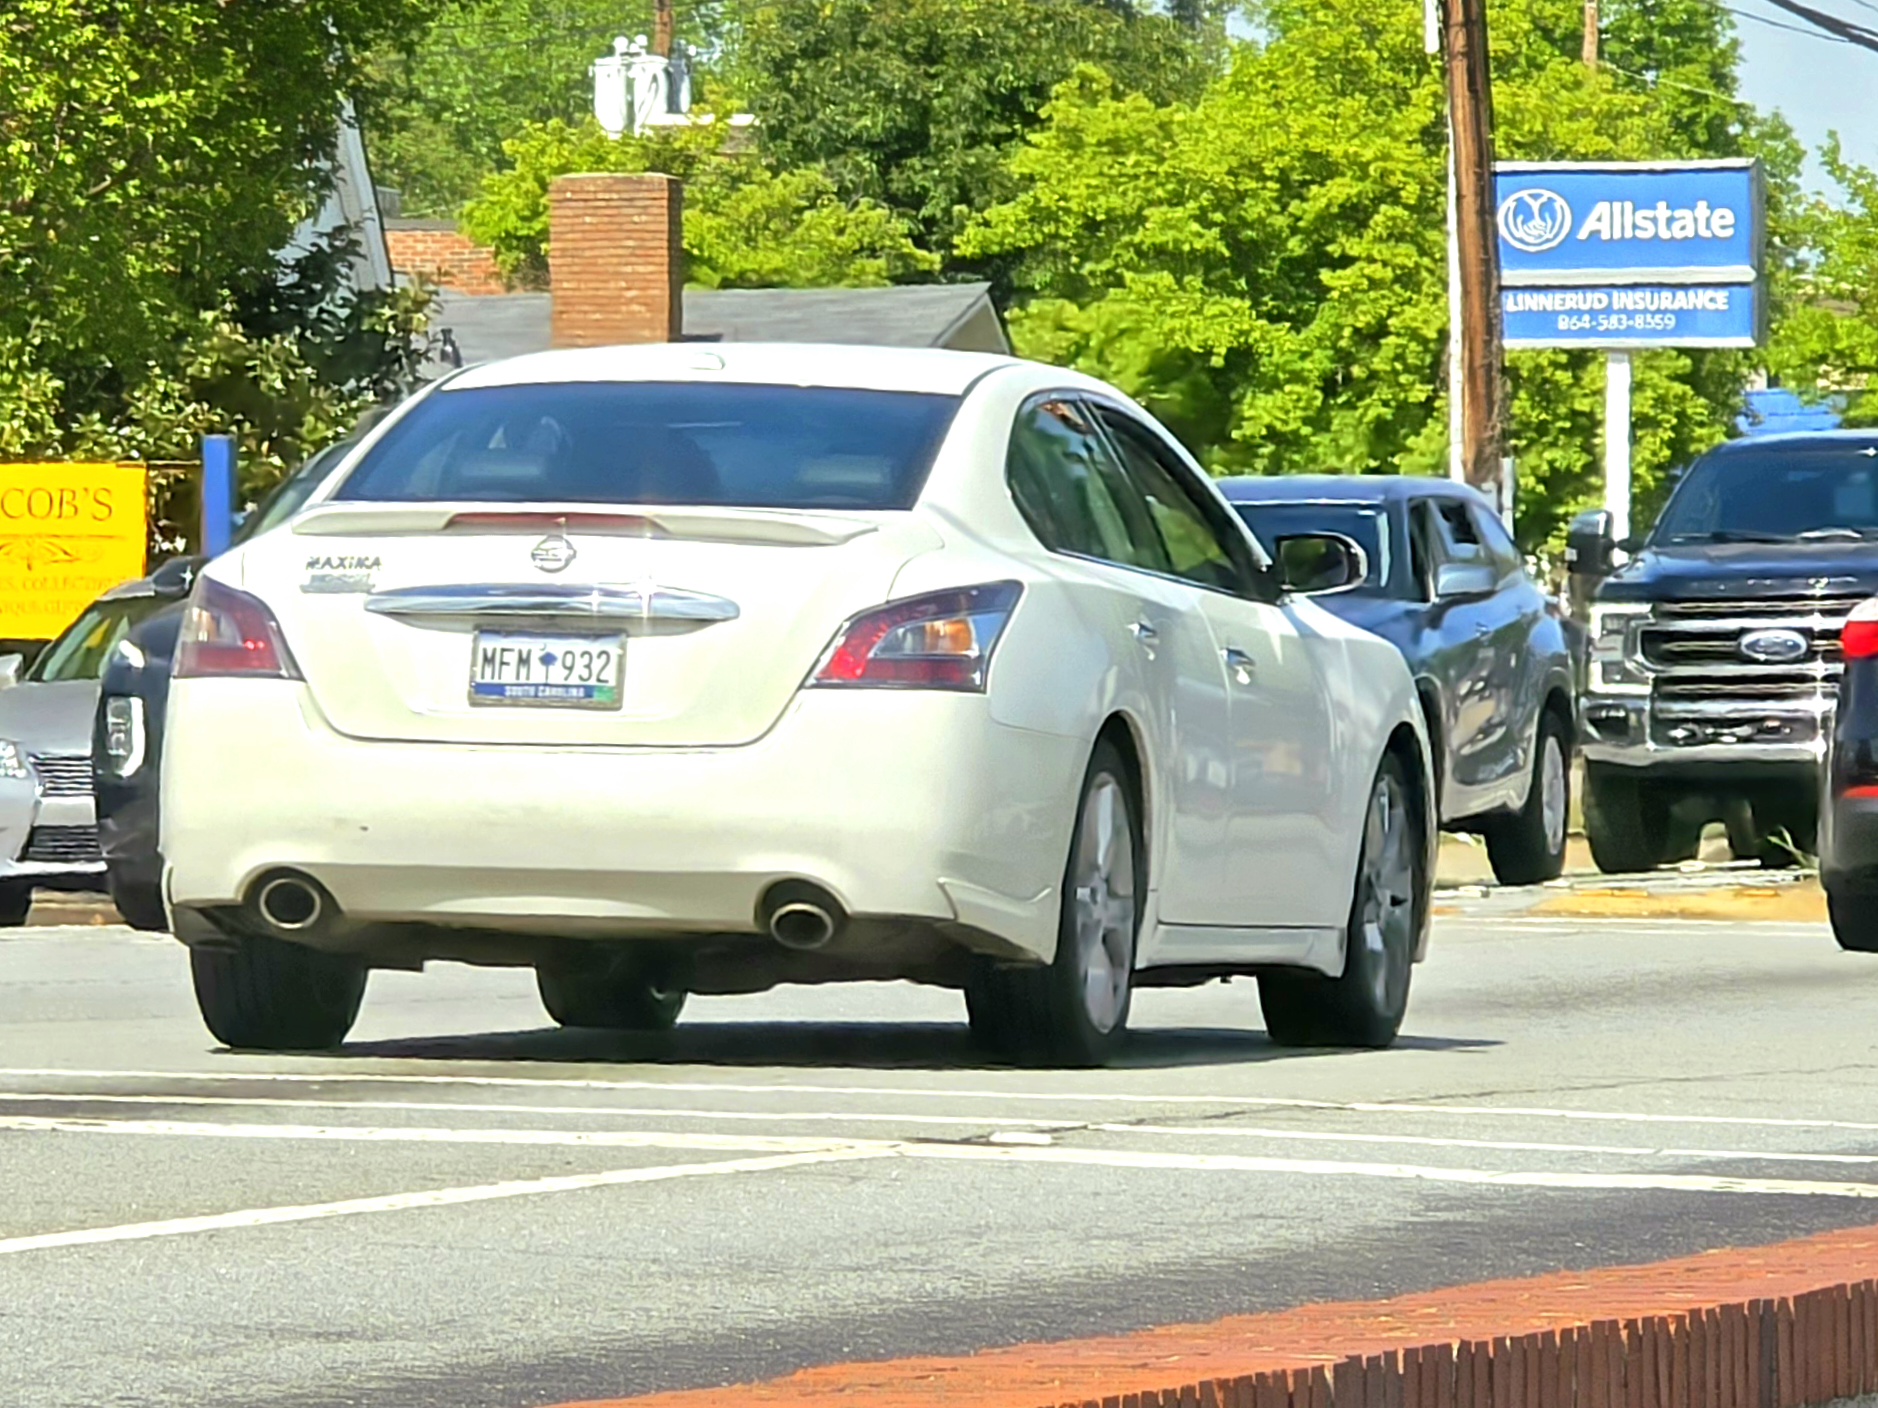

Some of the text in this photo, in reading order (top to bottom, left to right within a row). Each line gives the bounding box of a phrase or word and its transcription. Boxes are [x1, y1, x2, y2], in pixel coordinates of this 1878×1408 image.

[1577, 201, 1735, 240] Allstate
[1506, 291, 1729, 312] LINNERUD INSURANCE
[480, 647, 611, 684] MFM 932
